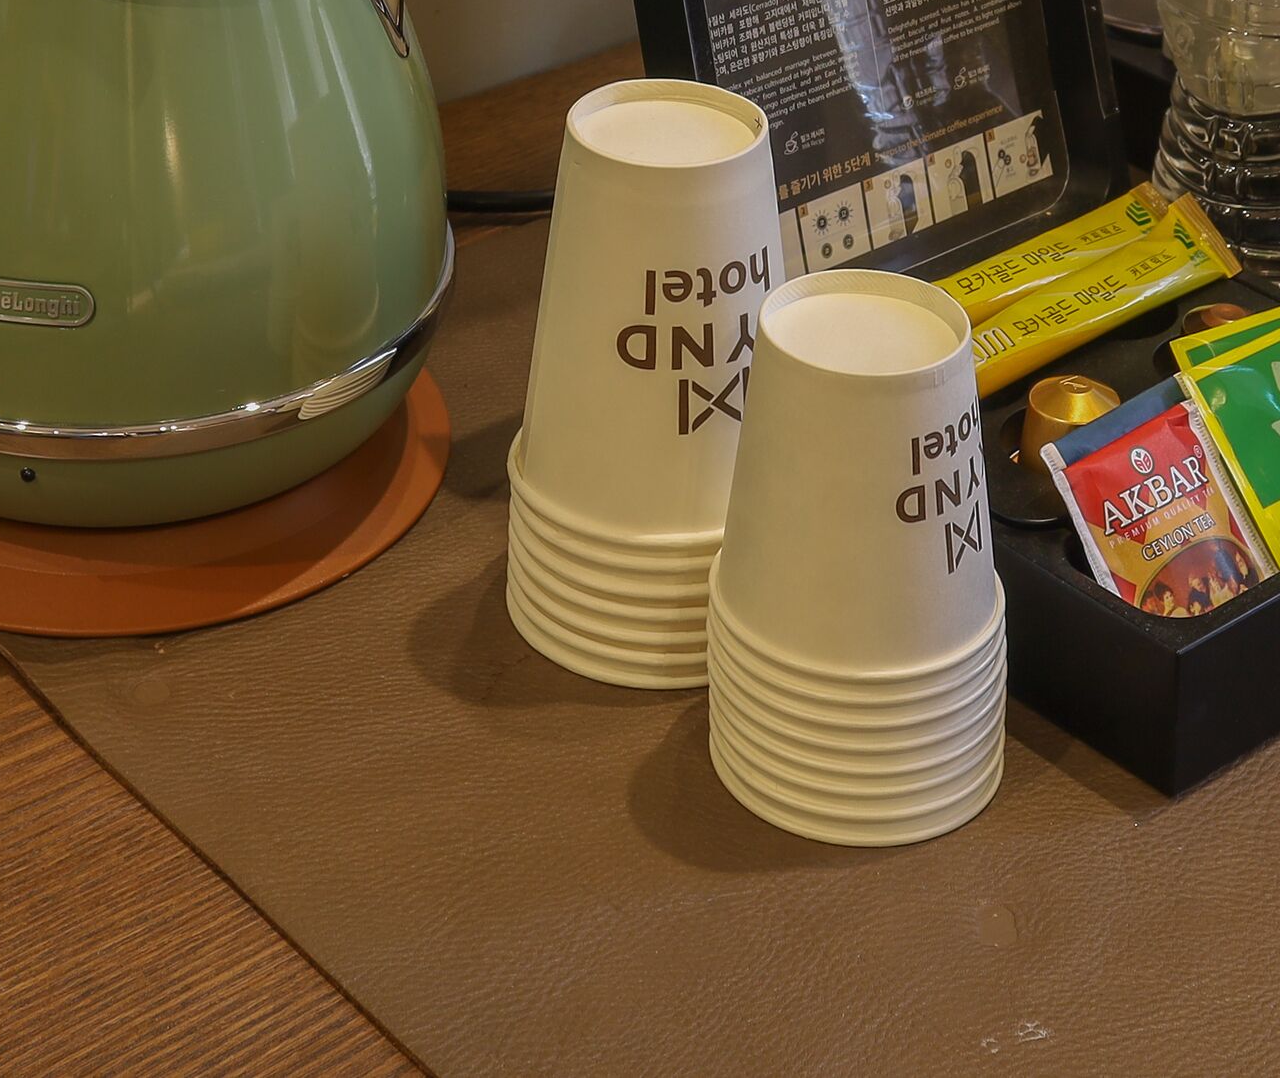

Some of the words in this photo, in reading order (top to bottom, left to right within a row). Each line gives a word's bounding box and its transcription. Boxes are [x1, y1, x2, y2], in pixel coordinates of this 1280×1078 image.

[756, 67, 782, 81] balanced
[790, 171, 821, 196] 즐기기
[822, 163, 844, 183] 위한
[844, 151, 872, 176] 5단계
[645, 245, 770, 315] hotel
[956, 259, 1028, 295] 모카골드
[1024, 241, 1077, 266] 마일드
[1078, 222, 1123, 244] 커피믹스
[1012, 298, 1080, 337] 모카골드
[1073, 274, 1128, 306] 마일드
[1128, 253, 1173, 278] 커피믹스
[616, 313, 755, 370] YND
[1103, 455, 1209, 536] AKBAR
[1109, 517, 1160, 549] PREMIUM
[1164, 495, 1200, 519] QUALITY
[1142, 523, 1195, 561] CEYLON
[1193, 512, 1216, 533] TEA
